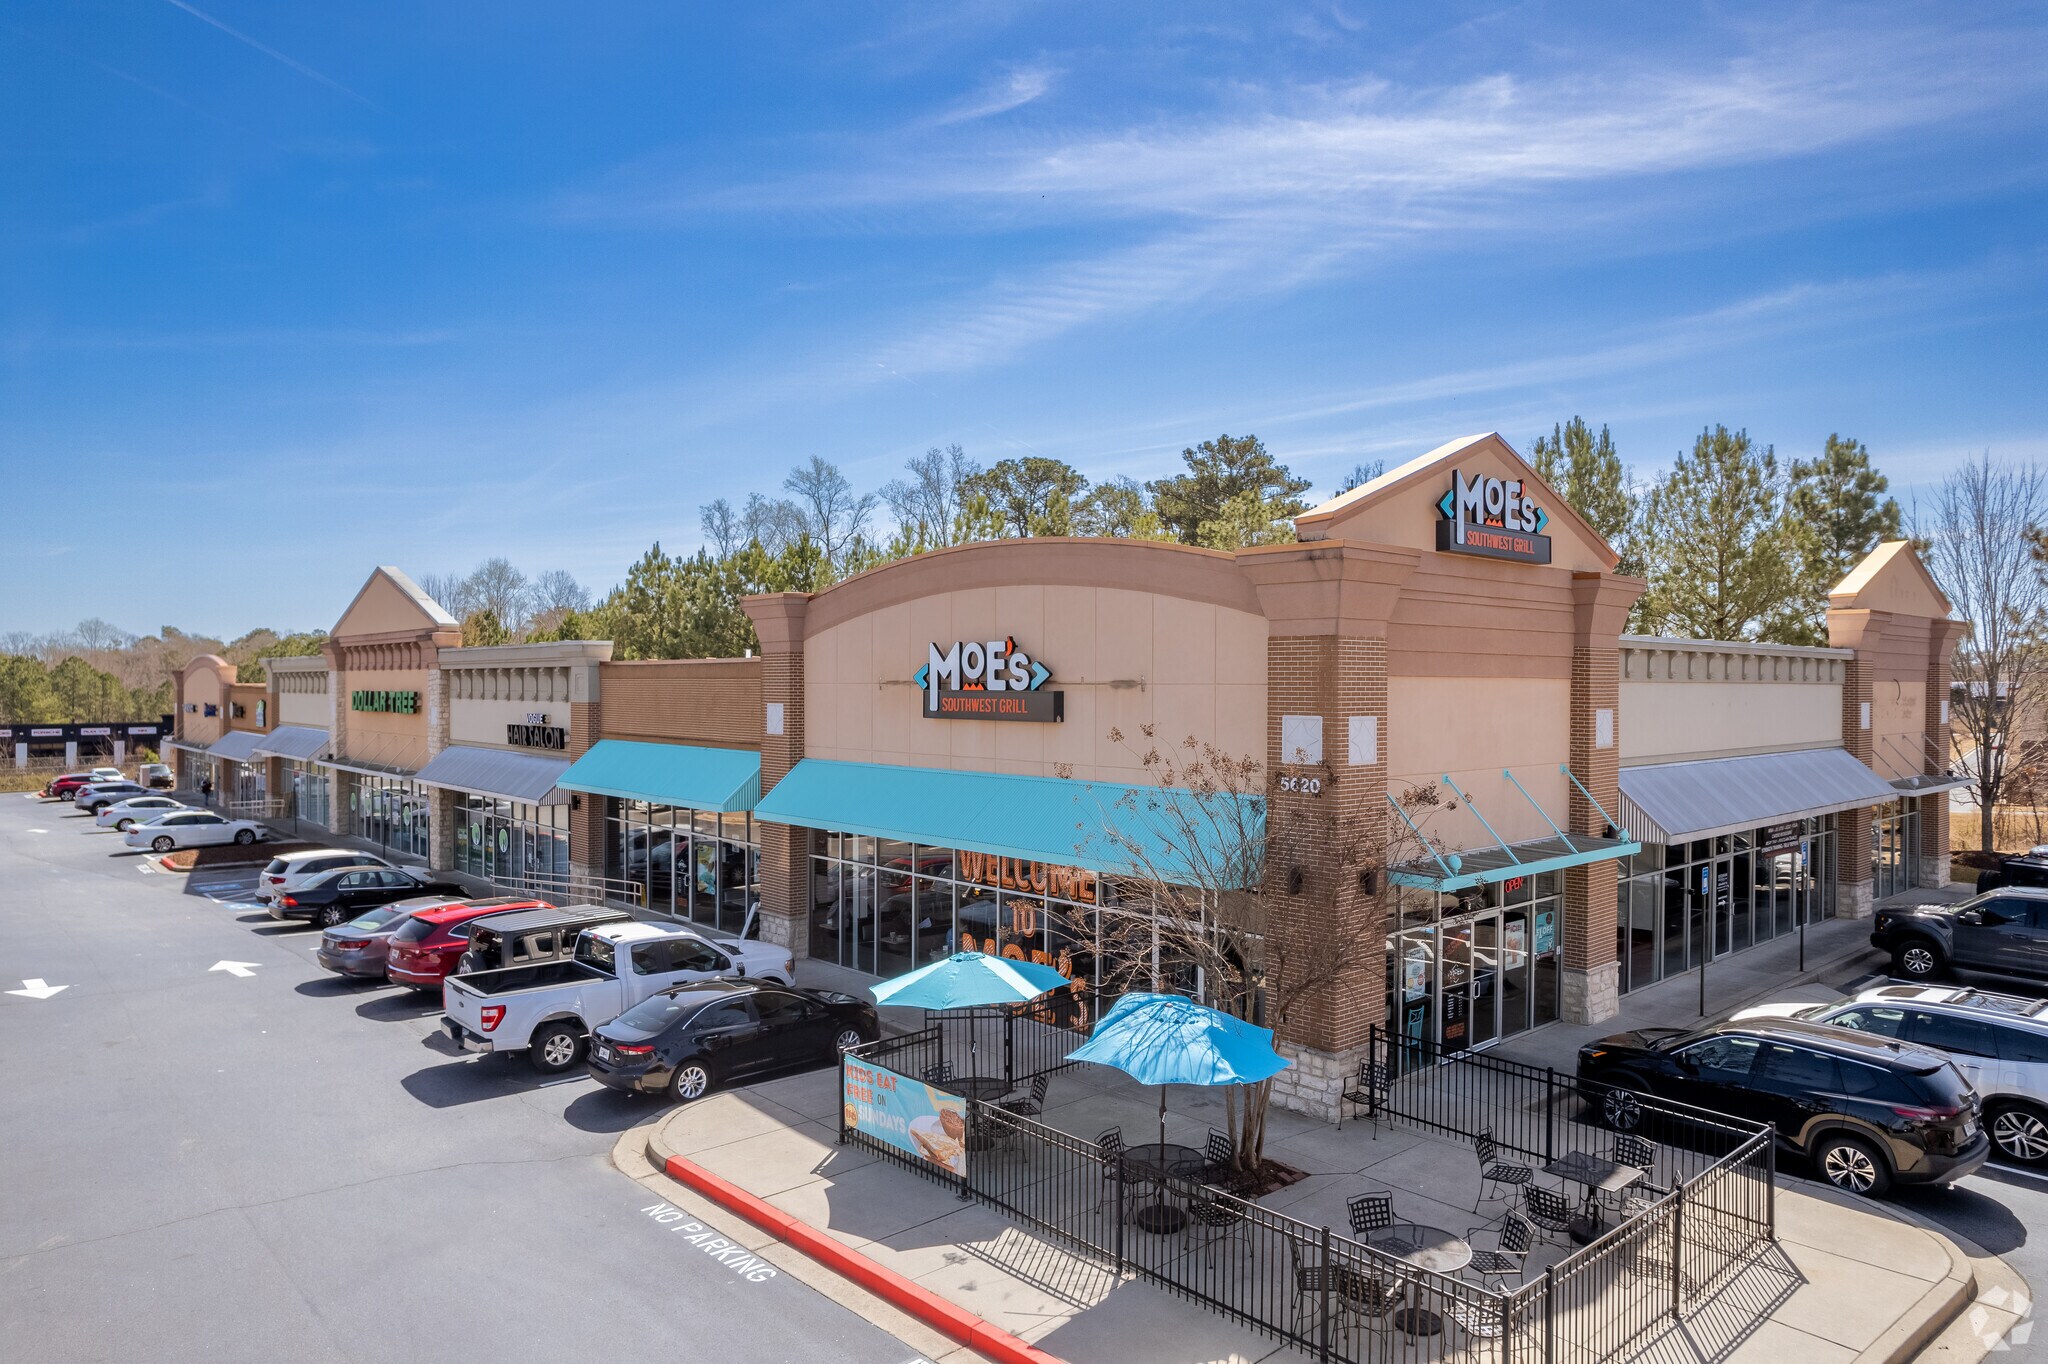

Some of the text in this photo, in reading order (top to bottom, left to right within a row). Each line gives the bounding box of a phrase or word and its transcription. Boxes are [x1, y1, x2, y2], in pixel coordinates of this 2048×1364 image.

[1467, 530, 1513, 551] SOUTHWEST
[352, 690, 415, 714] DOLLAR TREE
[942, 697, 998, 713] SOUTHWEST
[507, 724, 561, 749] HAIR SALON
[1505, 876, 1524, 893] OPEN
[846, 1064, 897, 1093] KIDS EAT
[846, 1083, 887, 1107] FREE ON
[858, 1105, 907, 1134] SUNDAYS
[640, 1202, 777, 1282] NO PARKING
